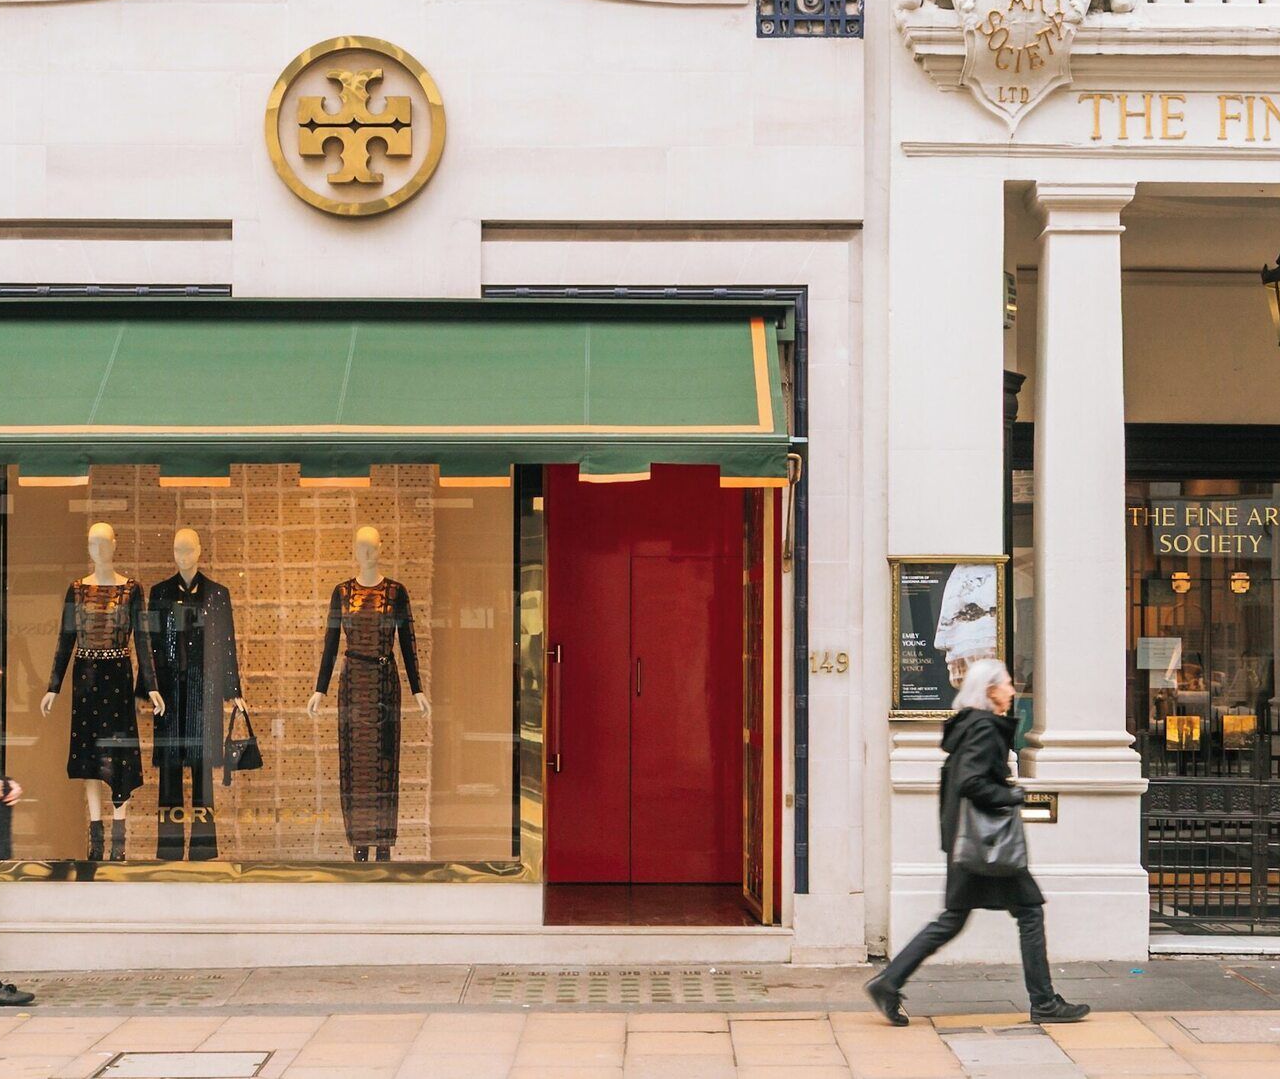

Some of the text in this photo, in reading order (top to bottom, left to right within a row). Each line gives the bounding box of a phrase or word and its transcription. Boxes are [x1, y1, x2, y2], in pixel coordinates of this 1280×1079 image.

[976, 10, 1065, 73] SOCIETY
[998, 87, 1029, 104] LTD
[1078, 93, 1187, 141] THE
[1128, 507, 1176, 526] THE
[1185, 507, 1238, 526] FINE
[1159, 534, 1262, 553] SOCIETY
[810, 650, 850, 674] 149
[158, 806, 222, 823] TORY
